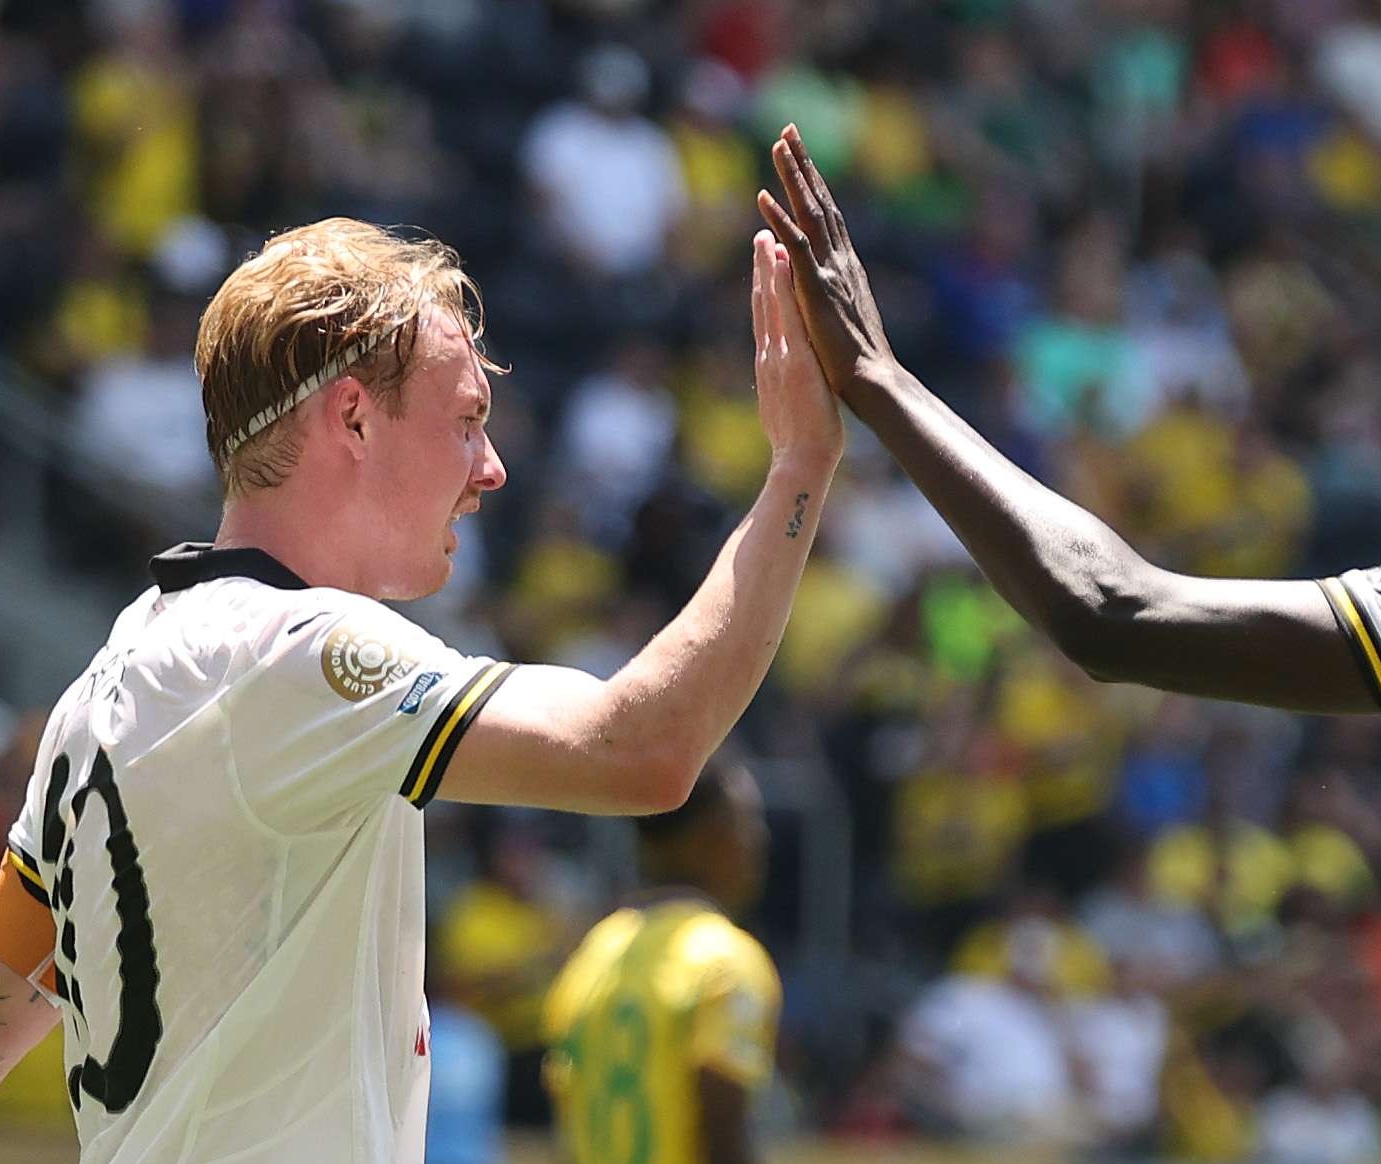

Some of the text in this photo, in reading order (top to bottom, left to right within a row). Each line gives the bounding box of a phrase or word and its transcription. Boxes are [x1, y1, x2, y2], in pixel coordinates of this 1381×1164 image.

[331, 633, 350, 679] WORLD
[343, 677, 375, 696] CLUB
[42, 746, 164, 1114] 10
